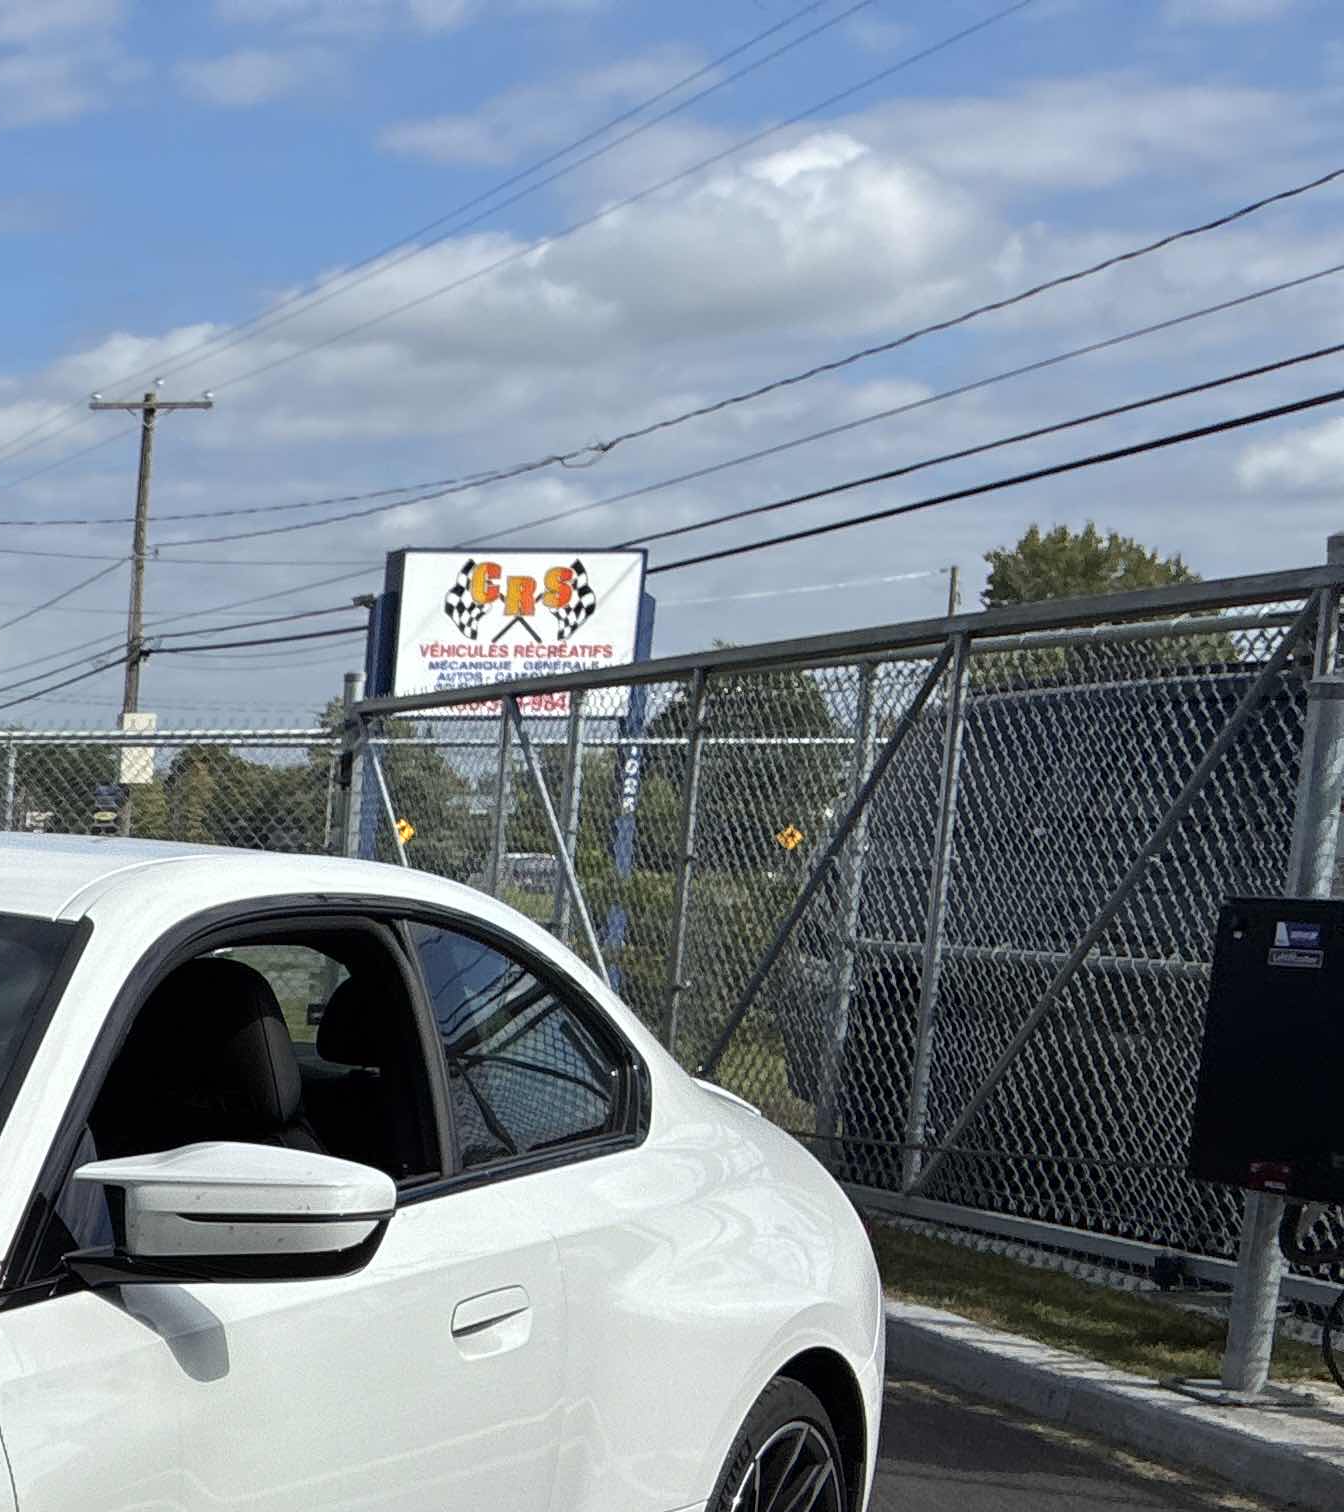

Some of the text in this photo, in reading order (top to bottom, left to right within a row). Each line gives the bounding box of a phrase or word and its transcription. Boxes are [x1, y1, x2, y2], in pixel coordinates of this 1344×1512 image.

[471, 561, 574, 616] CRS
[419, 642, 613, 658] VÉHICULES RÉCRÉATIFS
